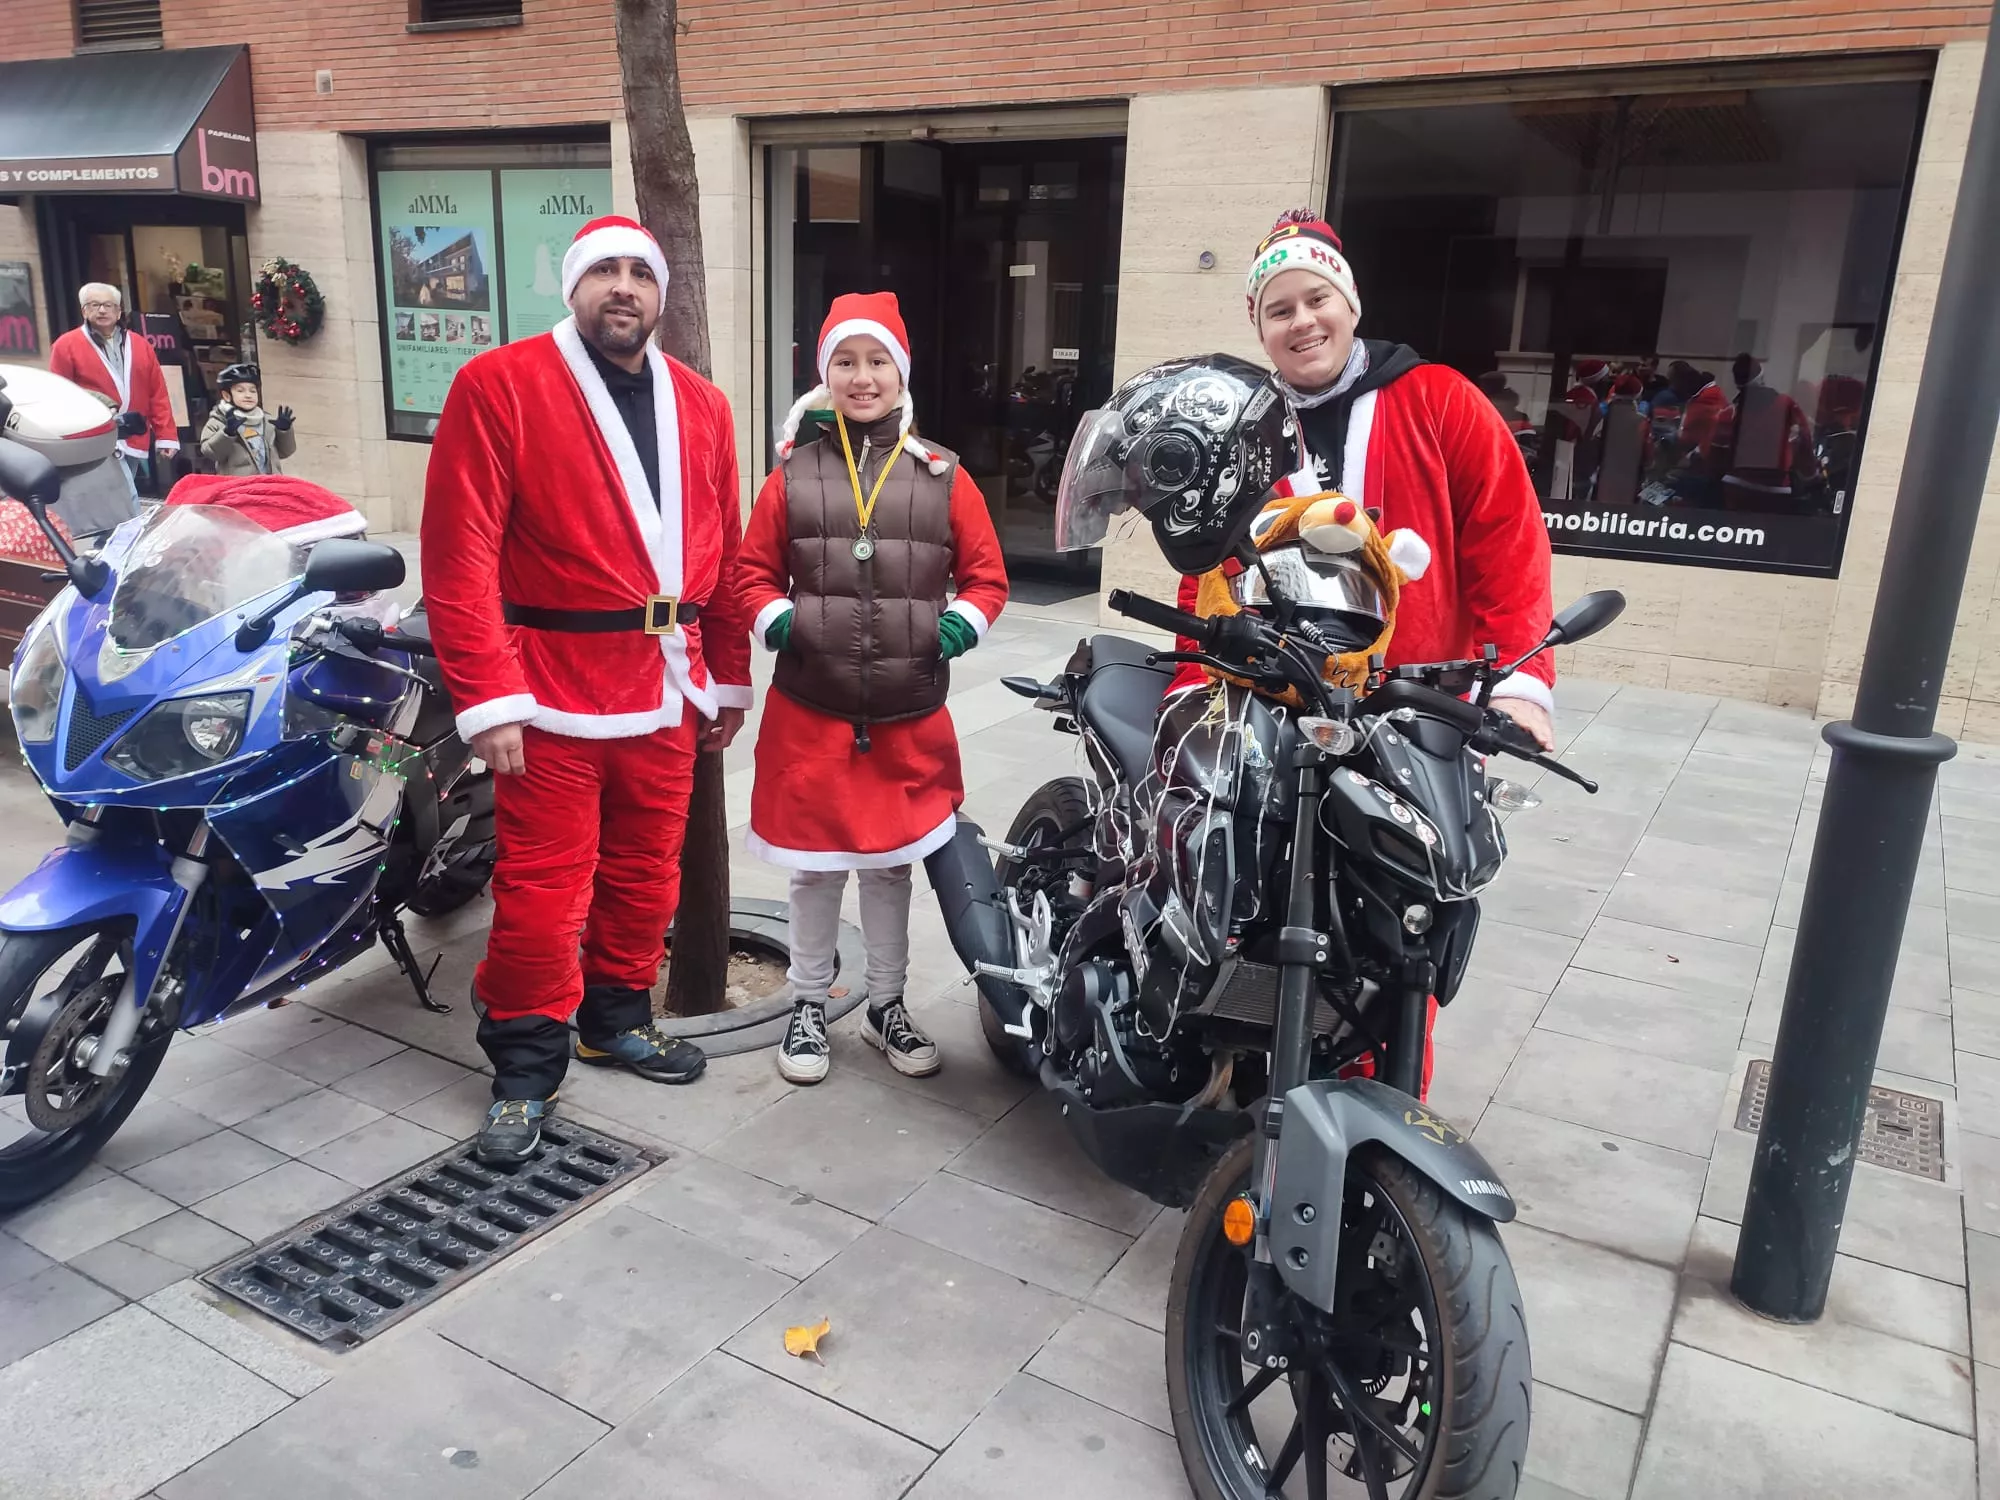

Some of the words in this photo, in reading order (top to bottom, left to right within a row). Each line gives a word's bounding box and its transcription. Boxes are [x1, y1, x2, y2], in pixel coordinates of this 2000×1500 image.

[12, 171, 23, 181] Y
[27, 167, 159, 181] COMPLEMENTOS
[198, 127, 255, 197] bm
[1310, 247, 1341, 272] HO
